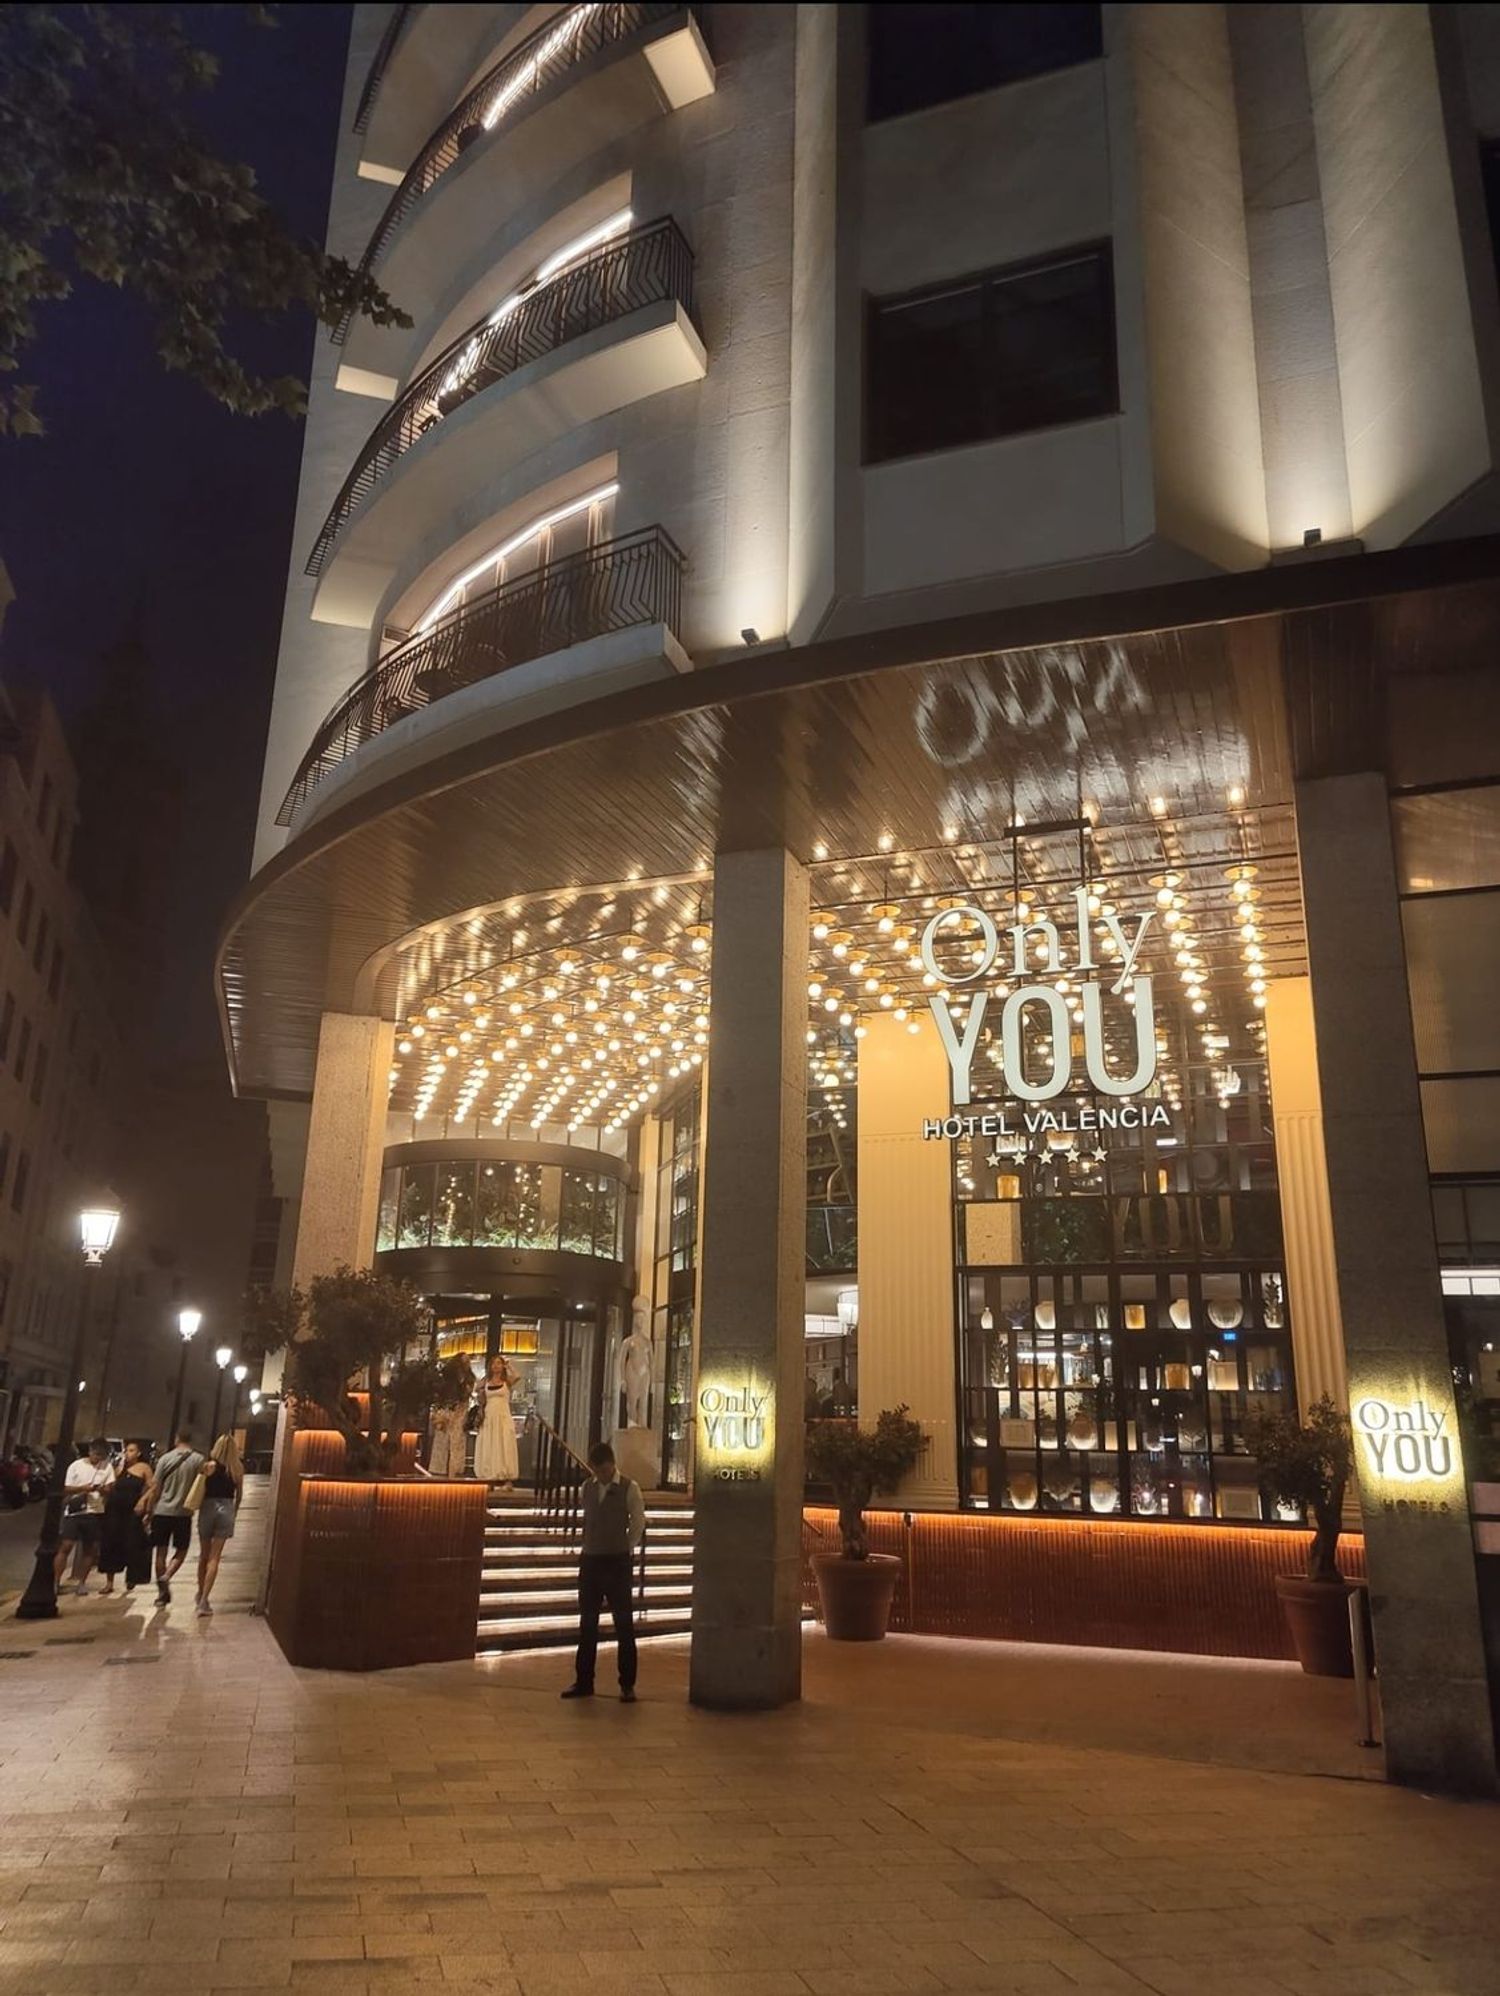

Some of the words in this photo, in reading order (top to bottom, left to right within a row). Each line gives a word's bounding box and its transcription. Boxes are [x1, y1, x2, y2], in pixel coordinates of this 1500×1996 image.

[921, 885, 1157, 995] Only
[928, 976, 1158, 1105] YOU
[922, 1115, 1015, 1141] HOTEL
[1023, 1105, 1172, 1134] VALENCIA
[700, 1387, 768, 1420] Only
[1358, 1400, 1447, 1441] Only
[704, 1416, 765, 1450] YOU
[1365, 1432, 1452, 1476] YOU
